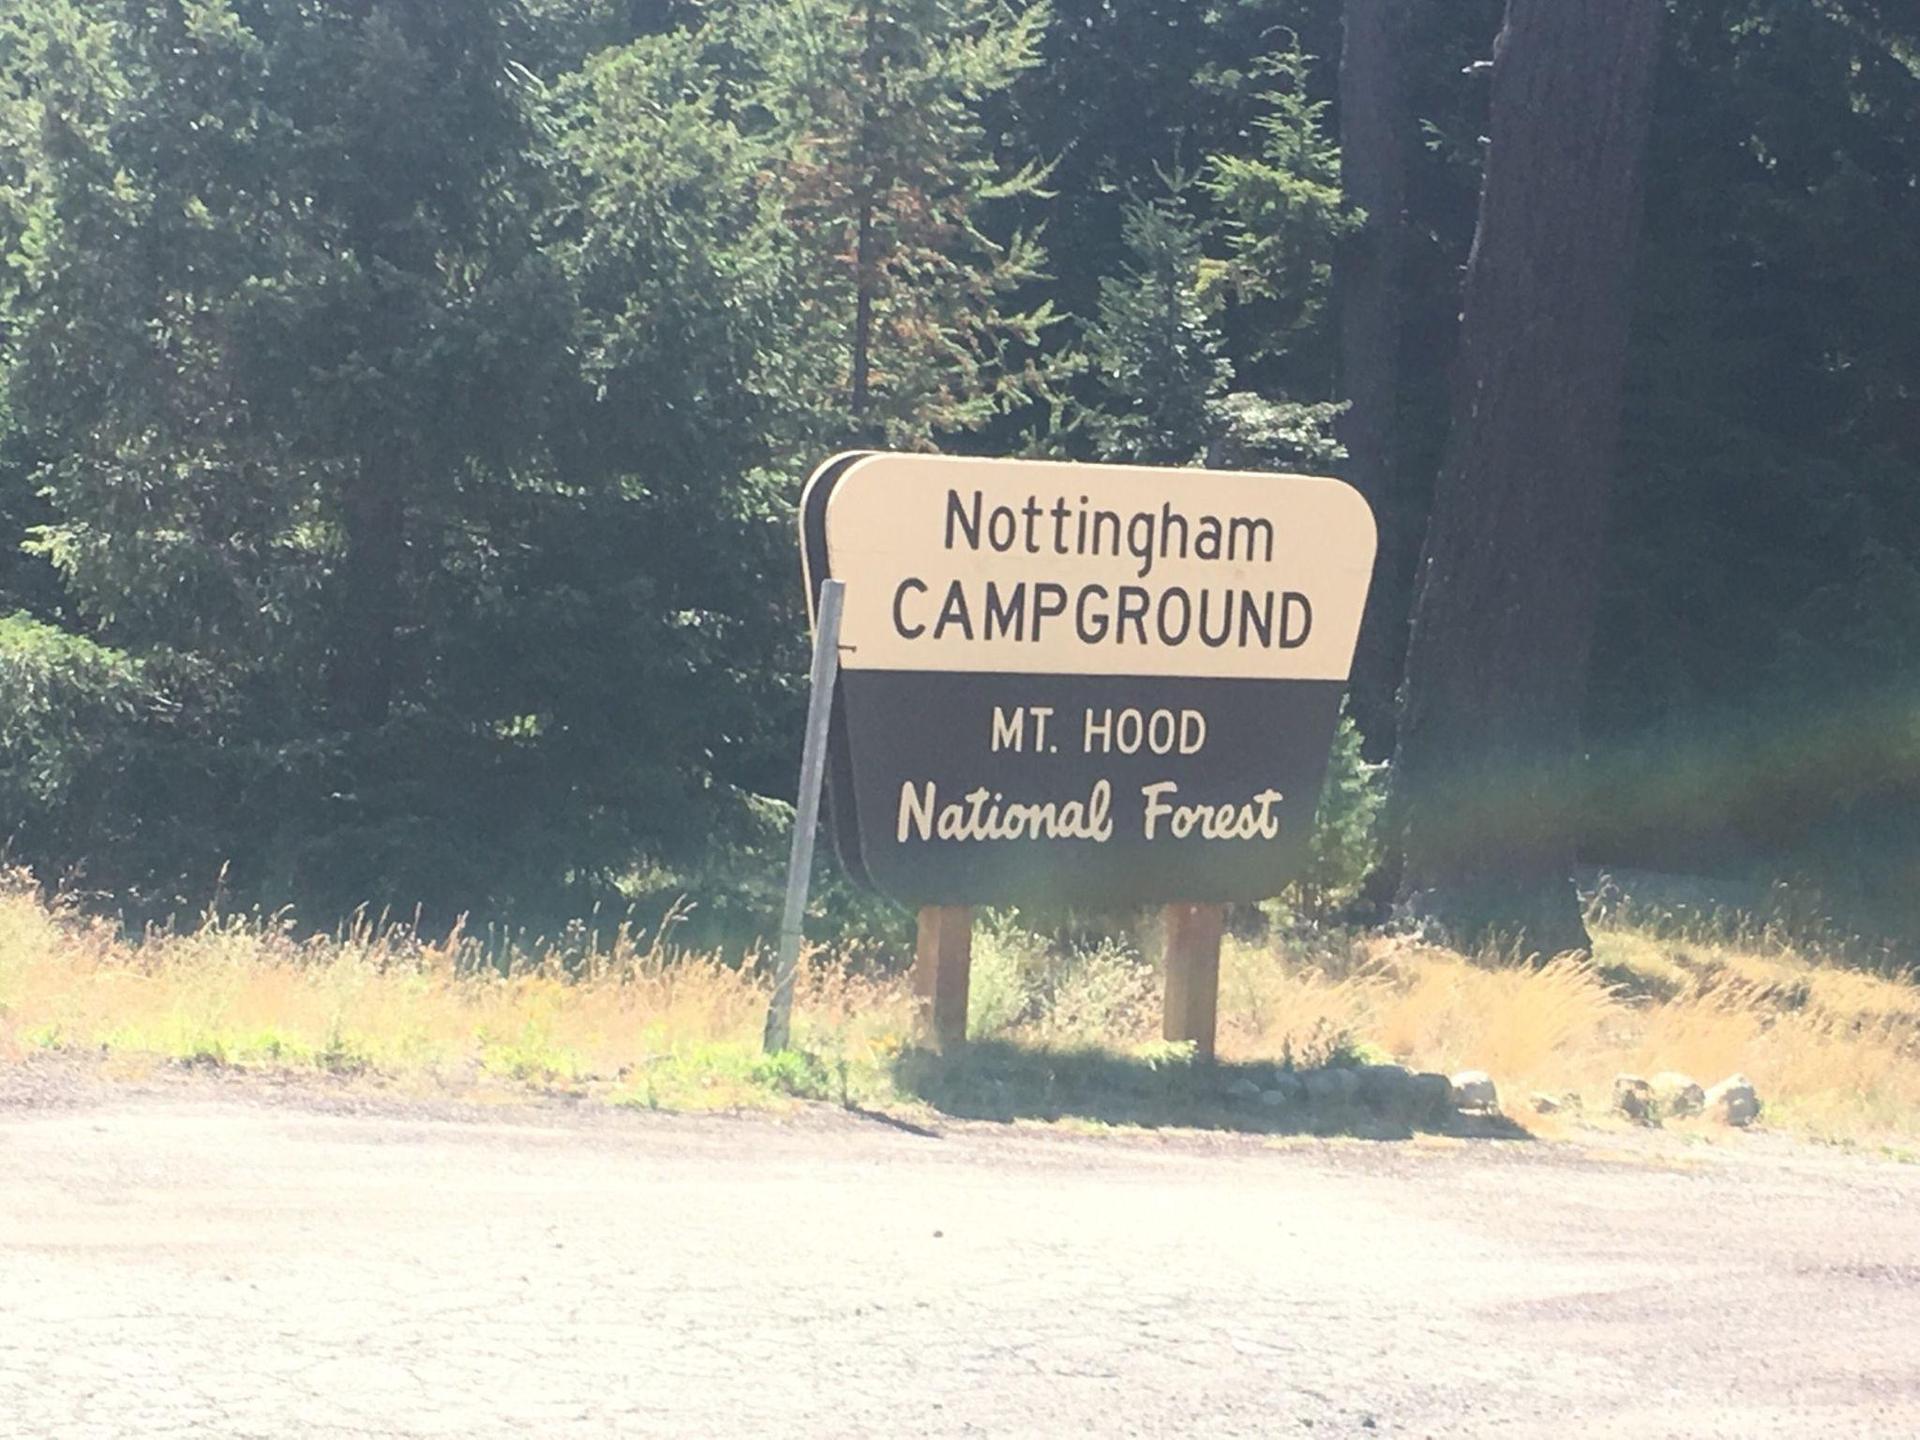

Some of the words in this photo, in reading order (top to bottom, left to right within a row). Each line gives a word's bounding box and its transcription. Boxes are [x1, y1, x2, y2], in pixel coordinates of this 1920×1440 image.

[944, 489, 1274, 579] Nottingham
[892, 577, 1313, 649] CAMPGROUND
[991, 706, 1057, 754] MT.
[1083, 708, 1206, 755] HOOD
[897, 779, 1113, 843] National
[1141, 781, 1284, 840] Forest
